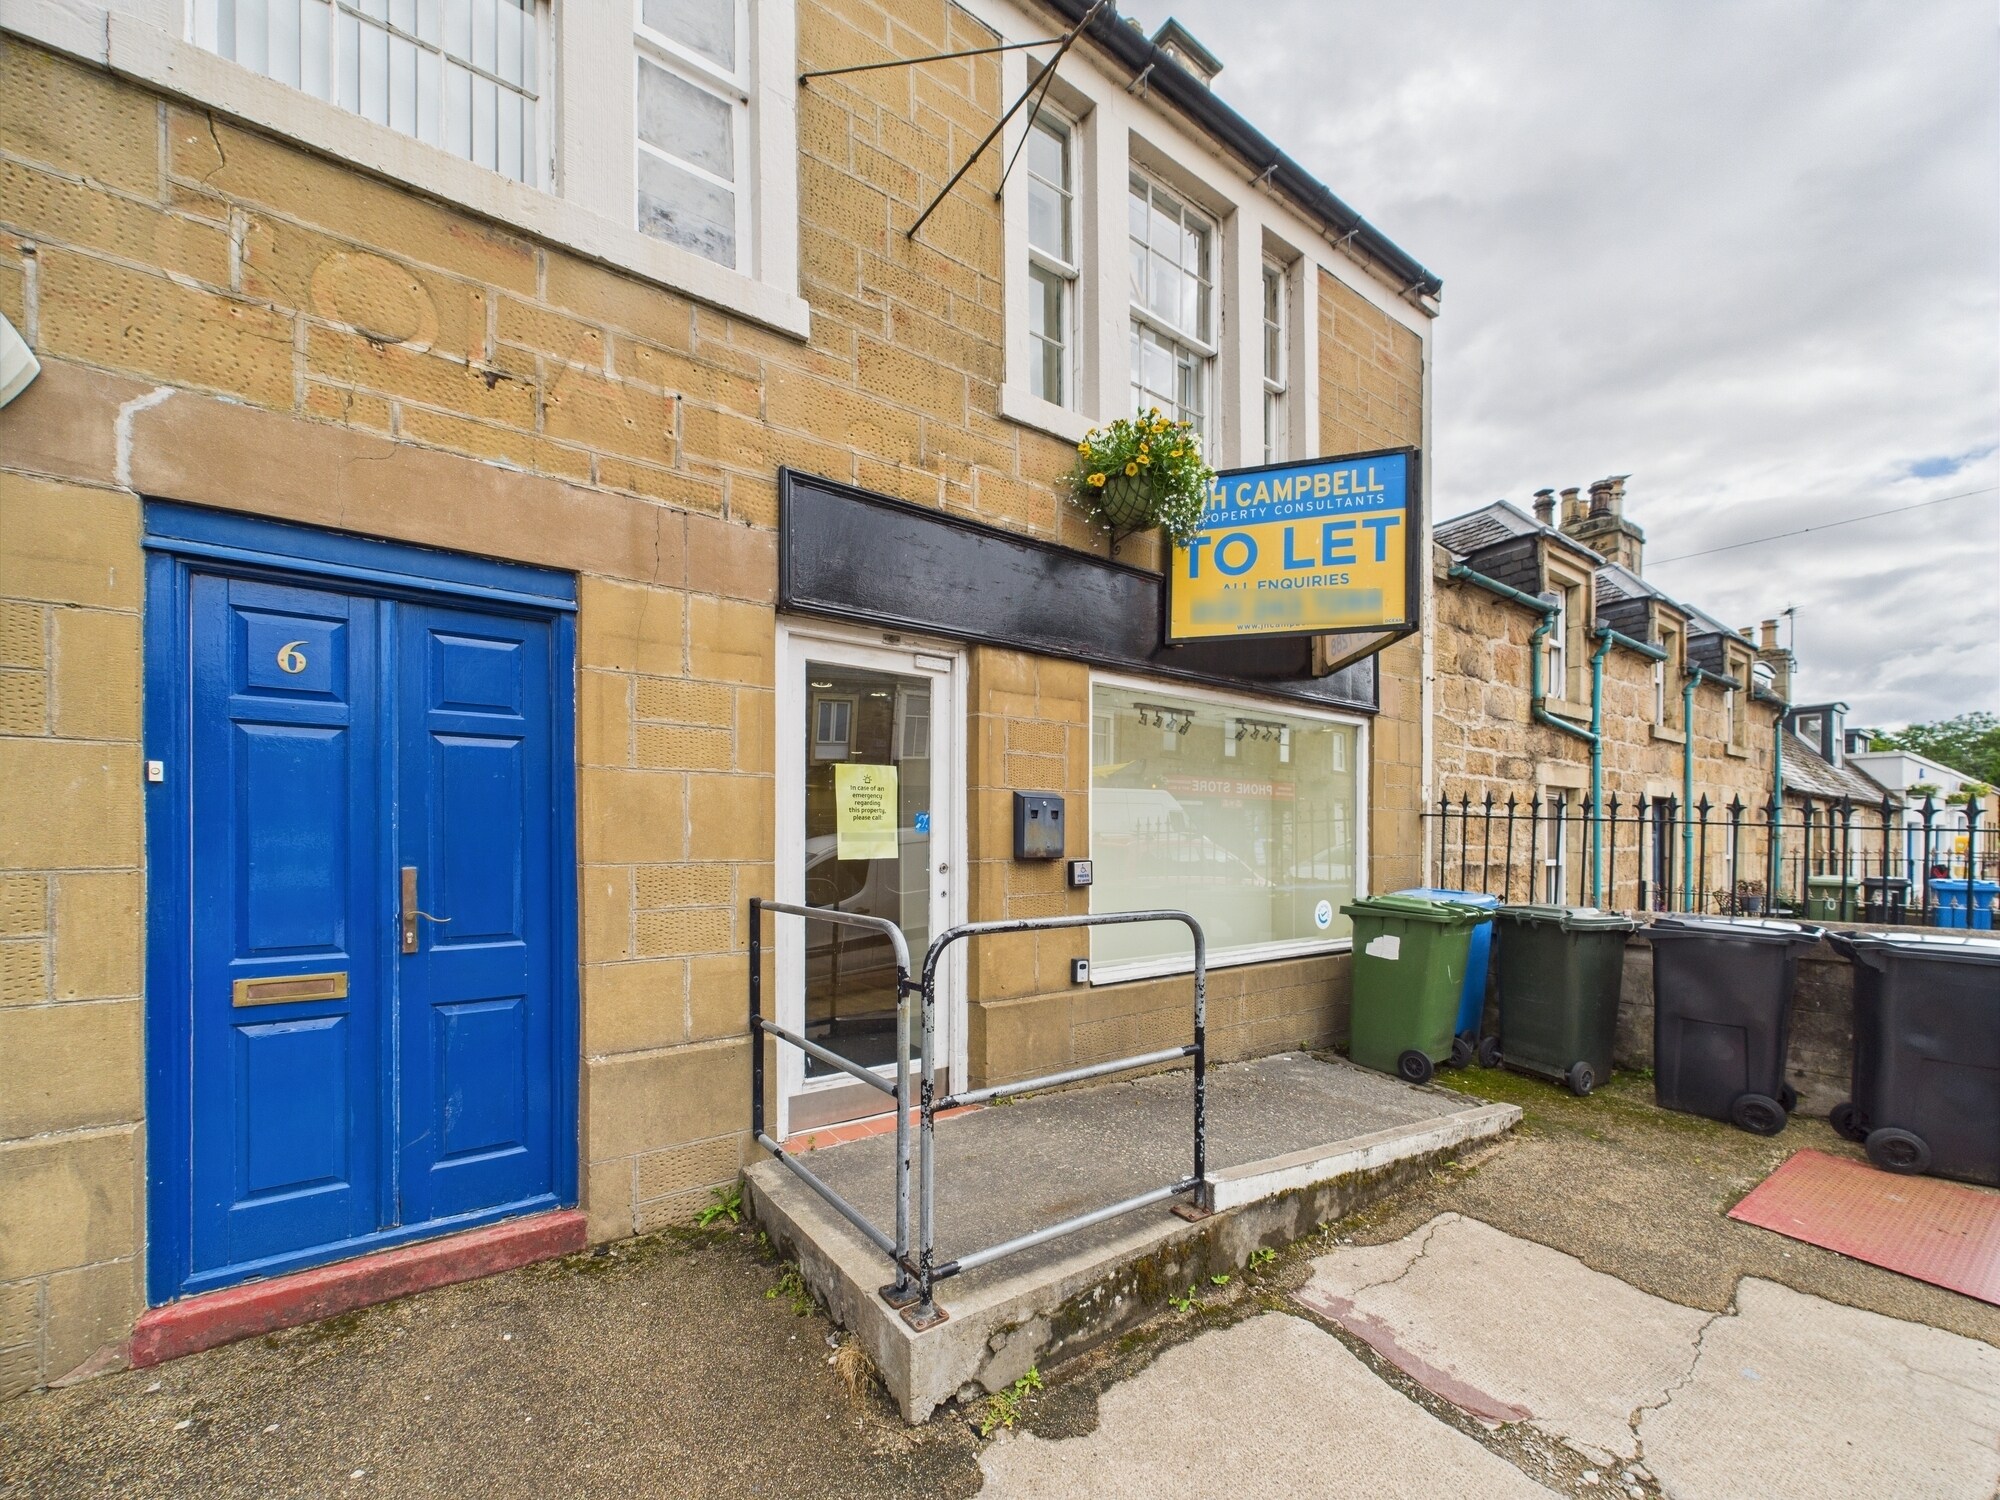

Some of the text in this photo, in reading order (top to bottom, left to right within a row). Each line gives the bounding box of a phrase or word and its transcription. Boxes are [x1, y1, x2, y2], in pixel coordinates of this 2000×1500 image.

[1200, 467, 1384, 511] H CAMPBELL
[1274, 493, 1385, 515] CONSULTANTS
[1179, 516, 1401, 579] TO LET
[1257, 572, 1350, 590] ENQUIRIES
[276, 640, 310, 675] 6
[853, 814, 871, 822] please
[861, 807, 887, 815] property,
